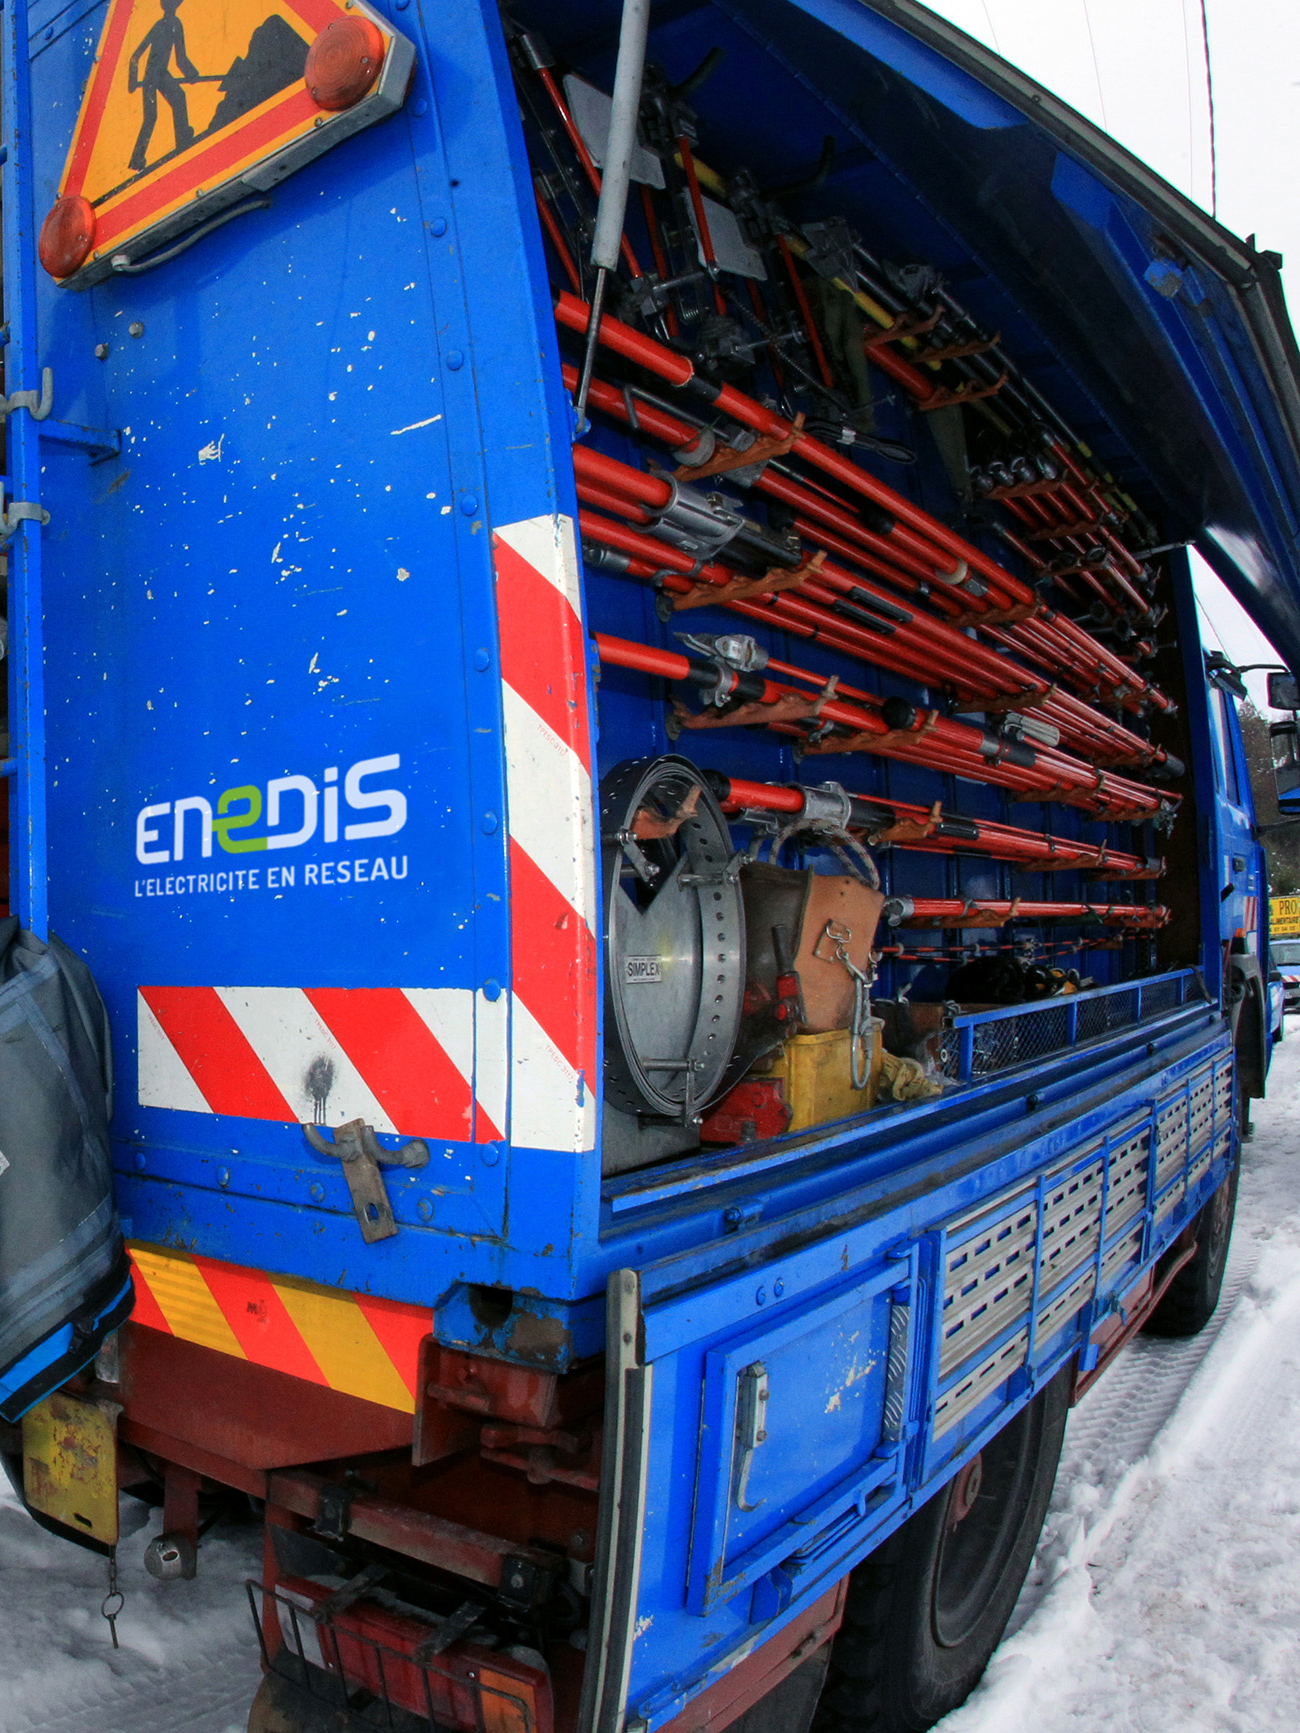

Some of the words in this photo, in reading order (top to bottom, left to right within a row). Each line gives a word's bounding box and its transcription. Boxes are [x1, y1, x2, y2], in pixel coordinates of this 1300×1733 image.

[134, 868, 260, 898] L'ELECTRICITE
[267, 865, 295, 888] EN
[304, 855, 408, 886] RESEAU
[1279, 899, 1297, 915] PRO
[628, 962, 660, 976] SIMPLEX
